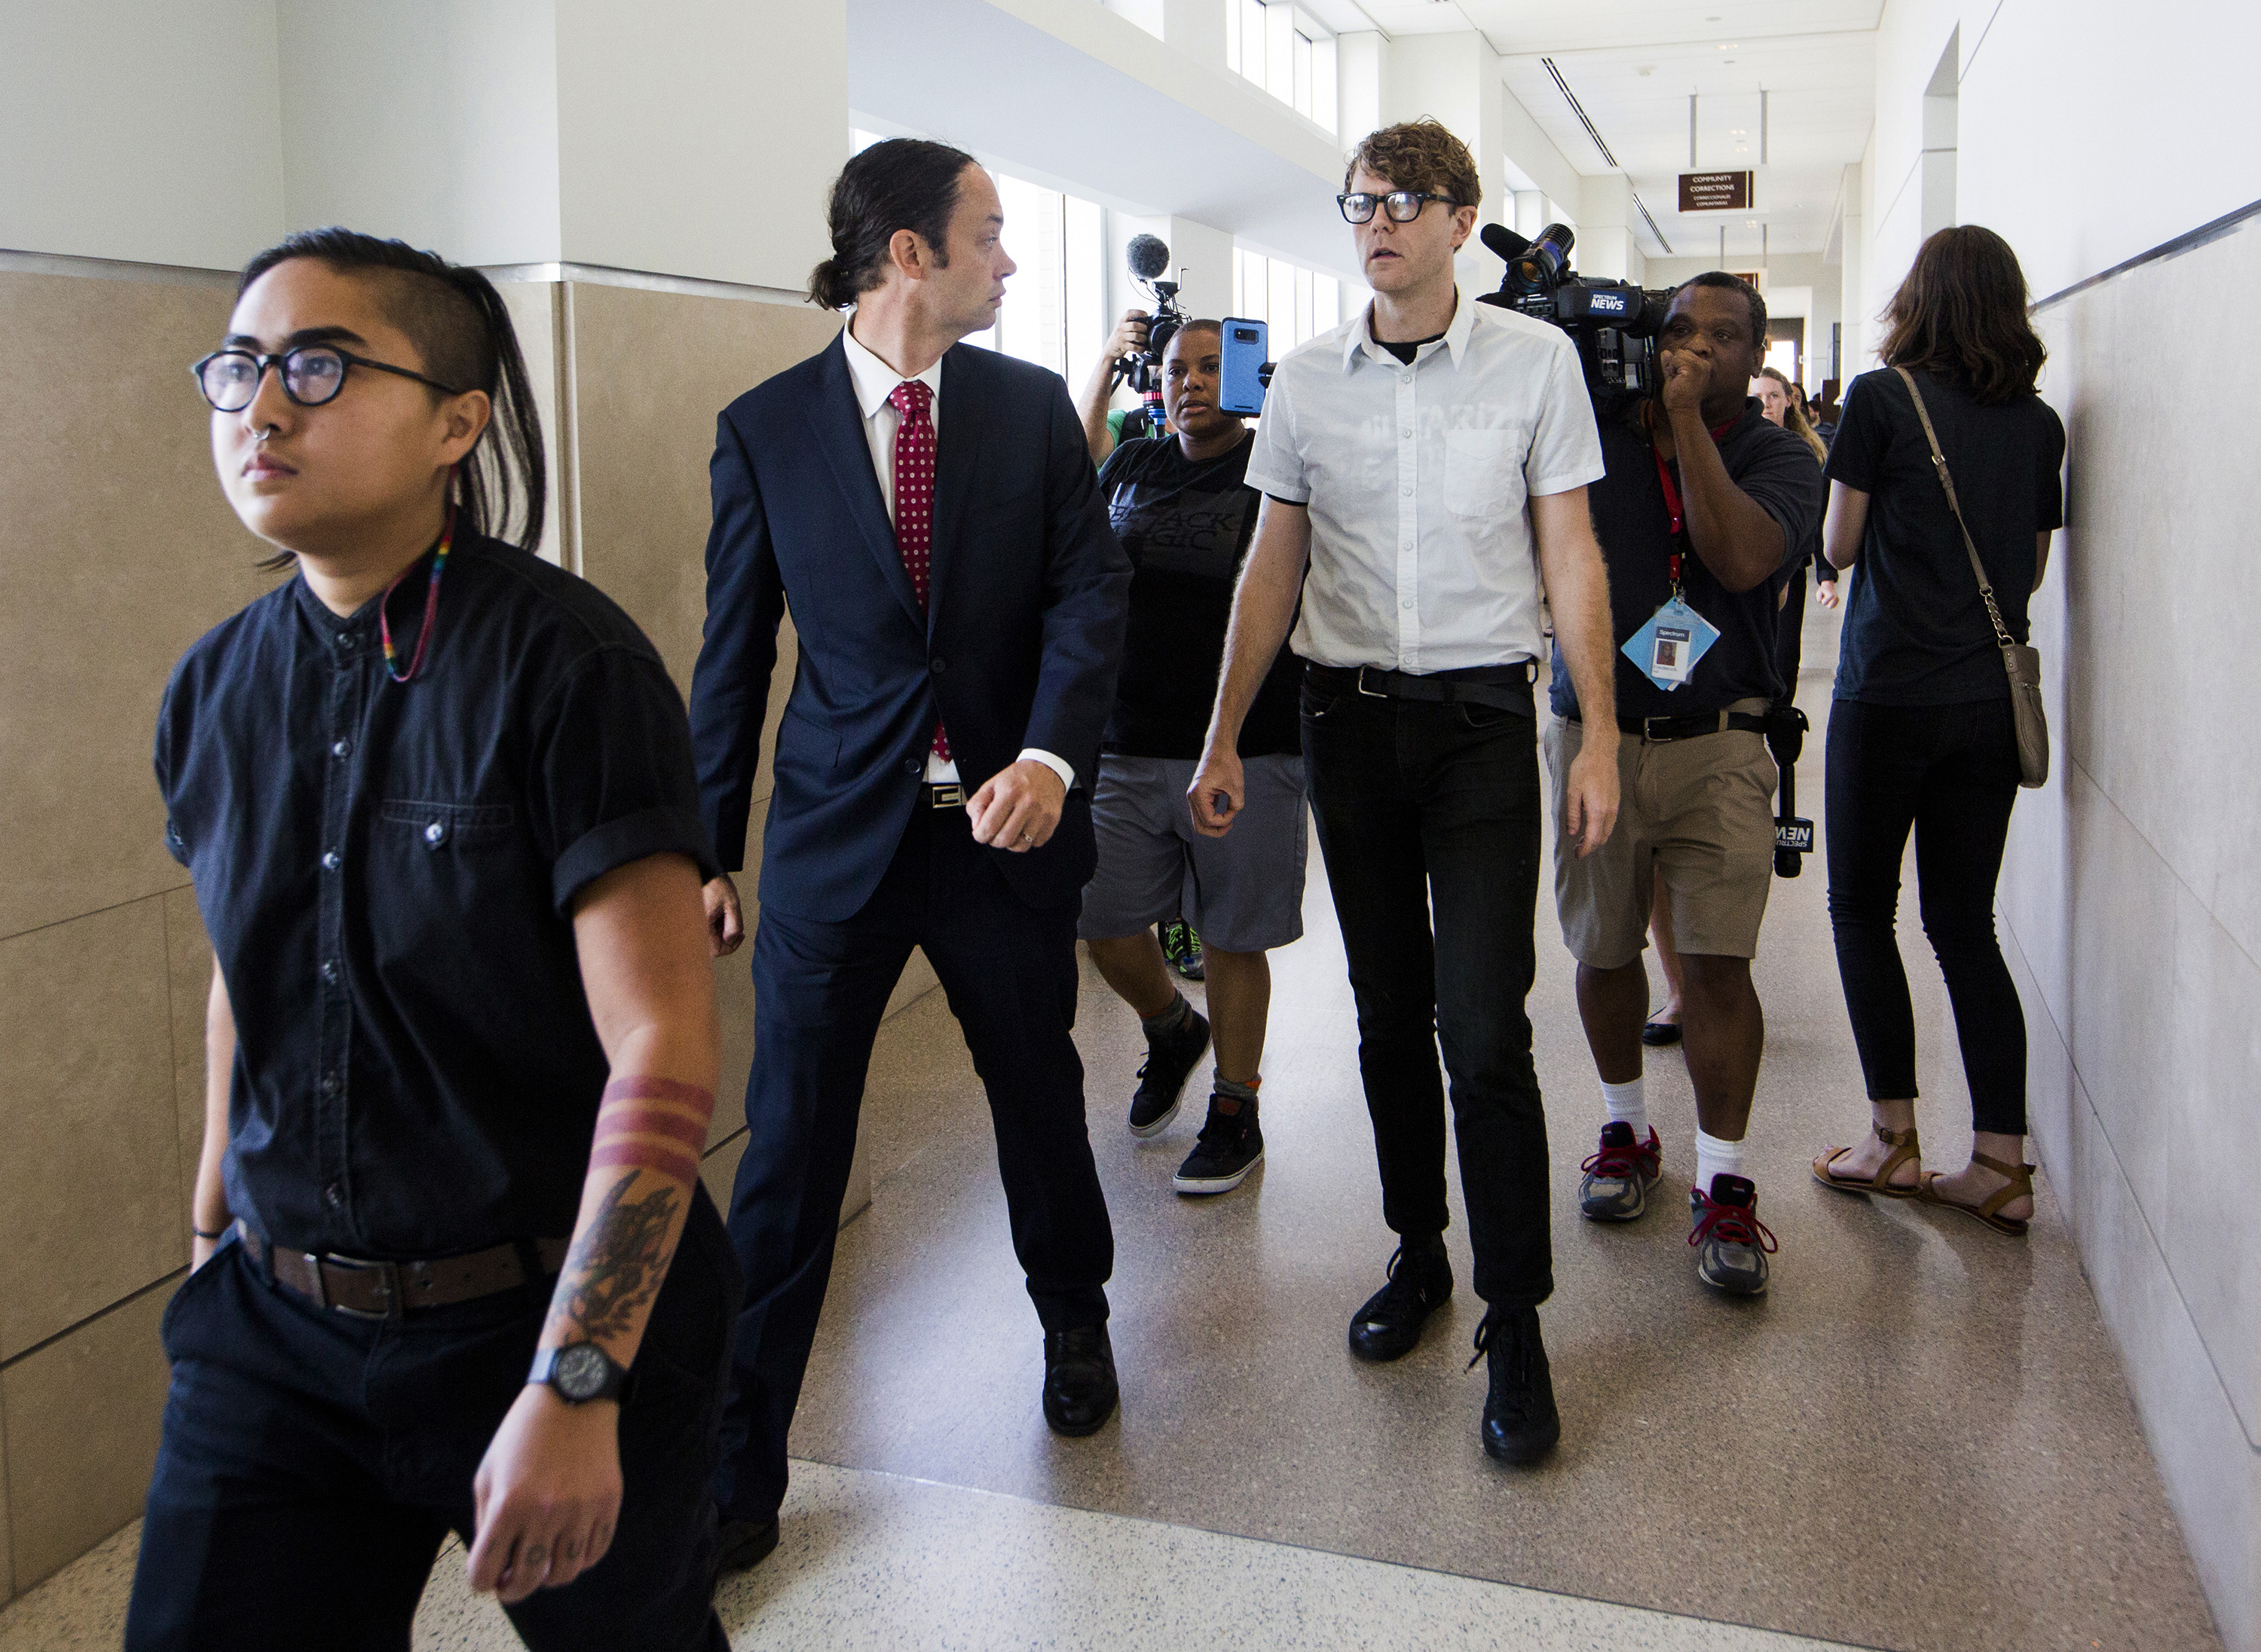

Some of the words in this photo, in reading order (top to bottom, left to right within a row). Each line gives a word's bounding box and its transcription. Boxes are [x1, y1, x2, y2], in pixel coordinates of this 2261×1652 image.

[1692, 175, 1732, 183] COMMUNITY
[1690, 184, 1735, 193] CORRECTIONS
[1590, 298, 1624, 311] NEWS
[1659, 629, 1685, 638] Spectrum
[1775, 826, 1810, 841] NEW
